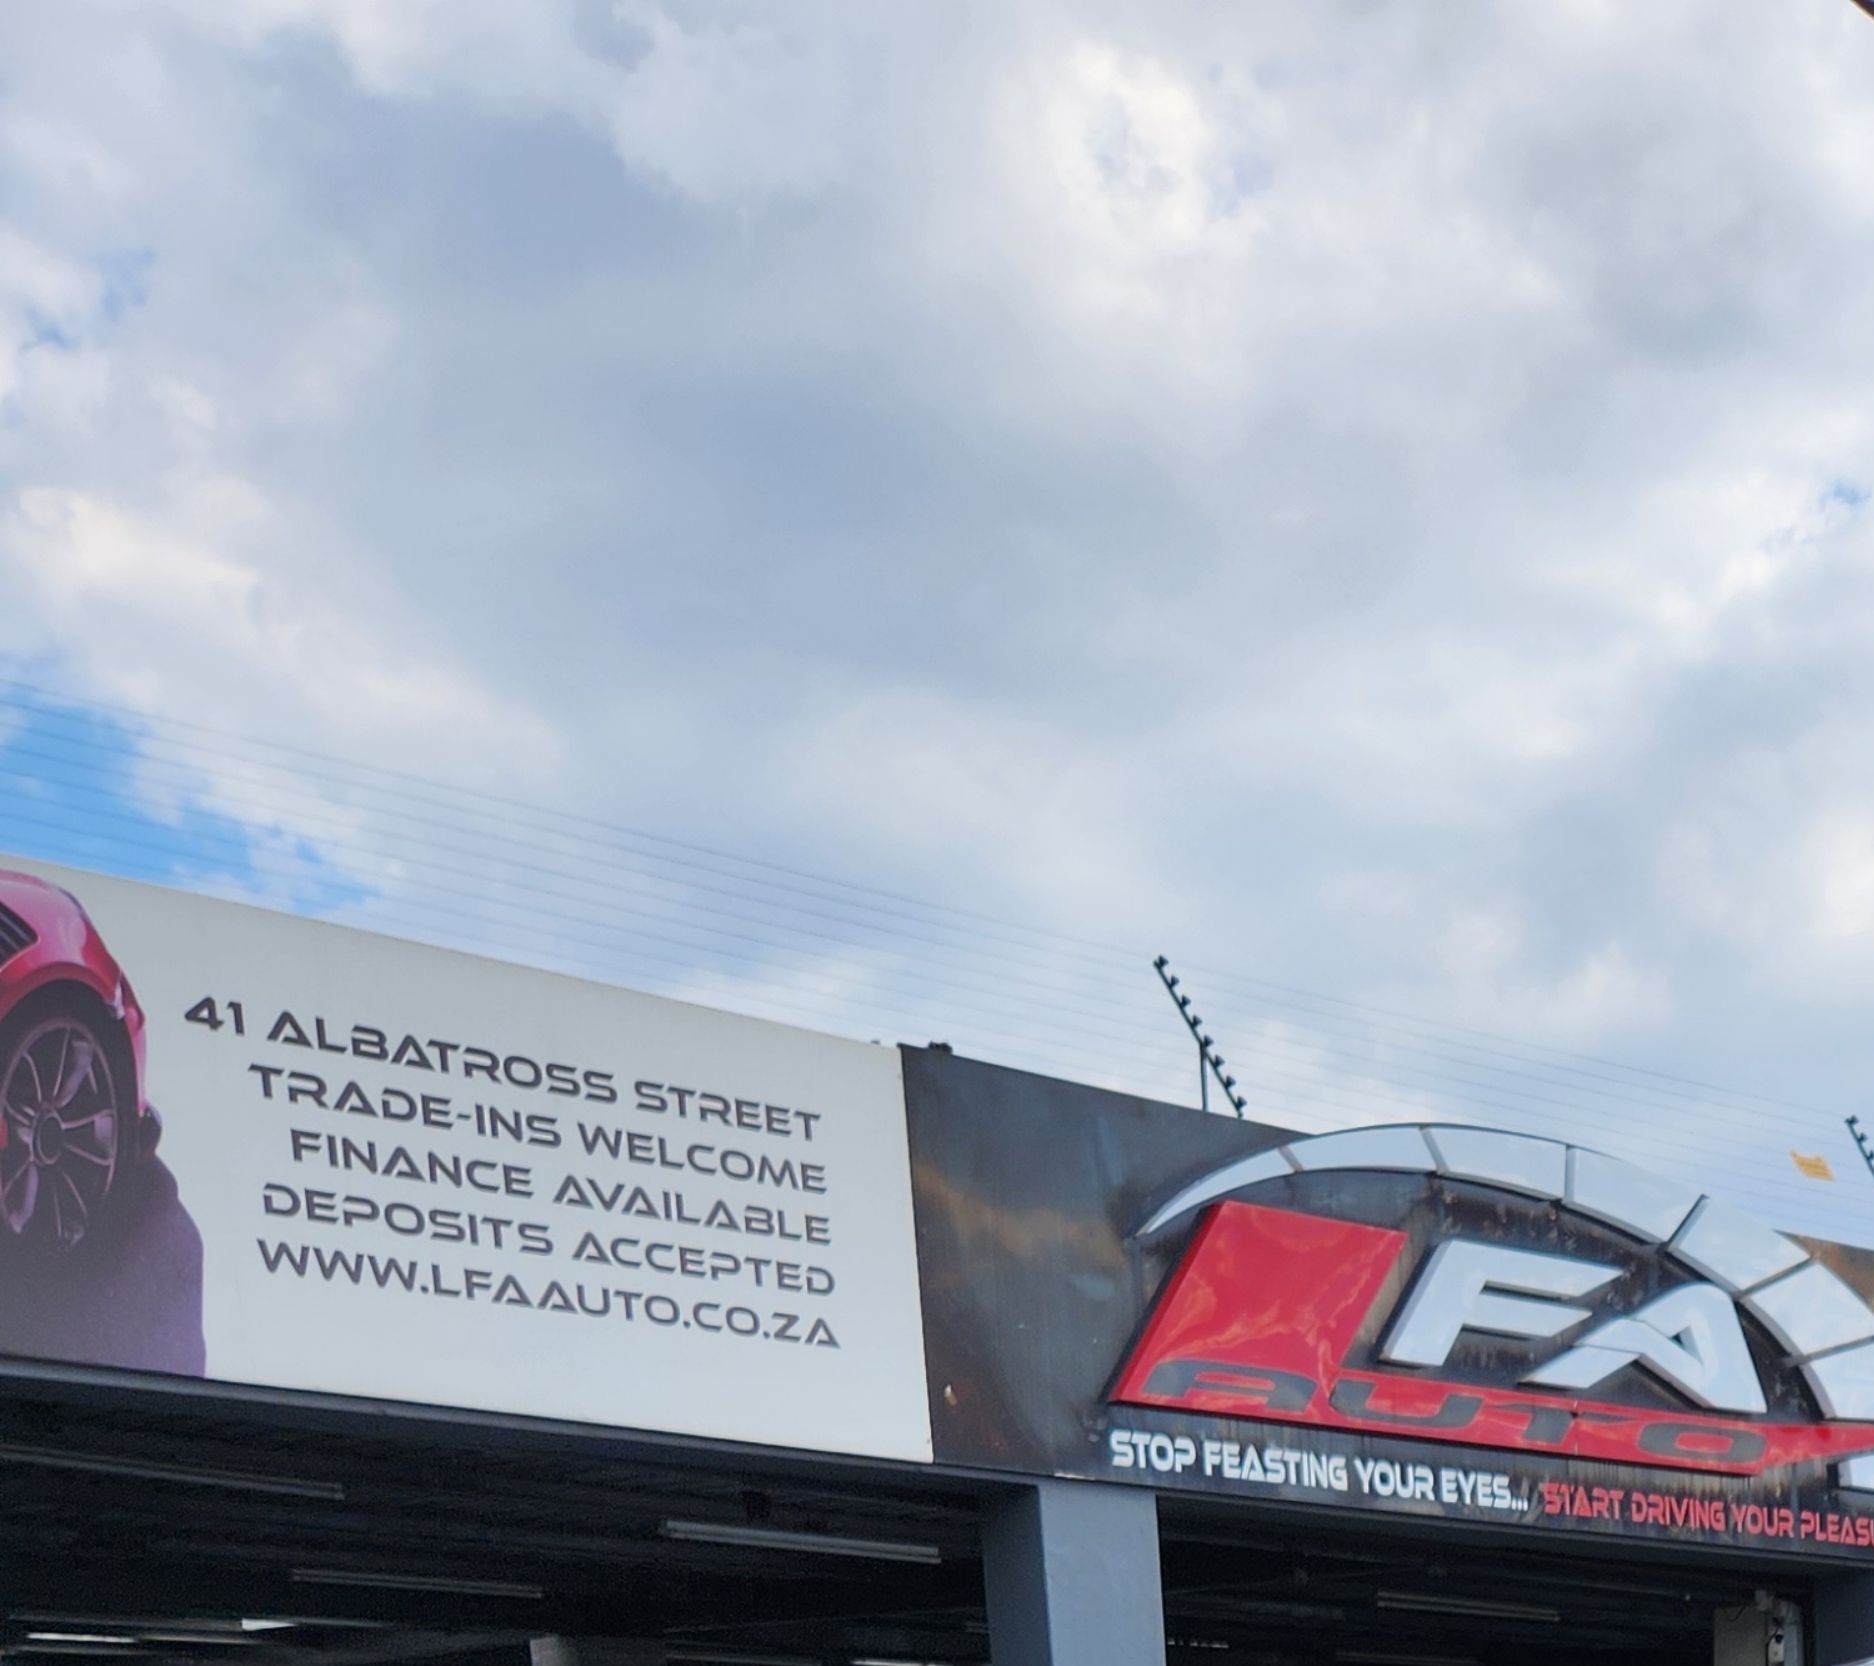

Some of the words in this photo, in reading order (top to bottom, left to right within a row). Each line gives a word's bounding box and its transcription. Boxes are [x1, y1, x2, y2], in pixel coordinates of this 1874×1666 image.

[185, 996, 246, 1036] 41
[266, 1011, 618, 1103] ALBATROSS
[633, 1080, 821, 1141] STREET
[249, 1064, 563, 1148] TRADE-INS
[577, 1122, 829, 1195] WELCOME
[263, 1183, 554, 1256] DEPOSITS
[572, 1232, 836, 1296] ACCEPTED
[289, 1128, 535, 1197] FINANCE
[553, 1175, 832, 1246] AVAILABLE
[257, 1239, 842, 1349] WWW.LFAAUTO.CO.ZA
[1142, 1358, 1767, 1462] AUTO
[1110, 1430, 1196, 1473] STOP
[1203, 1440, 1349, 1491] FEASTING
[1355, 1460, 1436, 1500] YOUR
[1440, 1471, 1529, 1512] EYES...
[1542, 1482, 1624, 1518] START
[1631, 1492, 1726, 1532] DRIVING
[1734, 1504, 1795, 1538] YOUR
